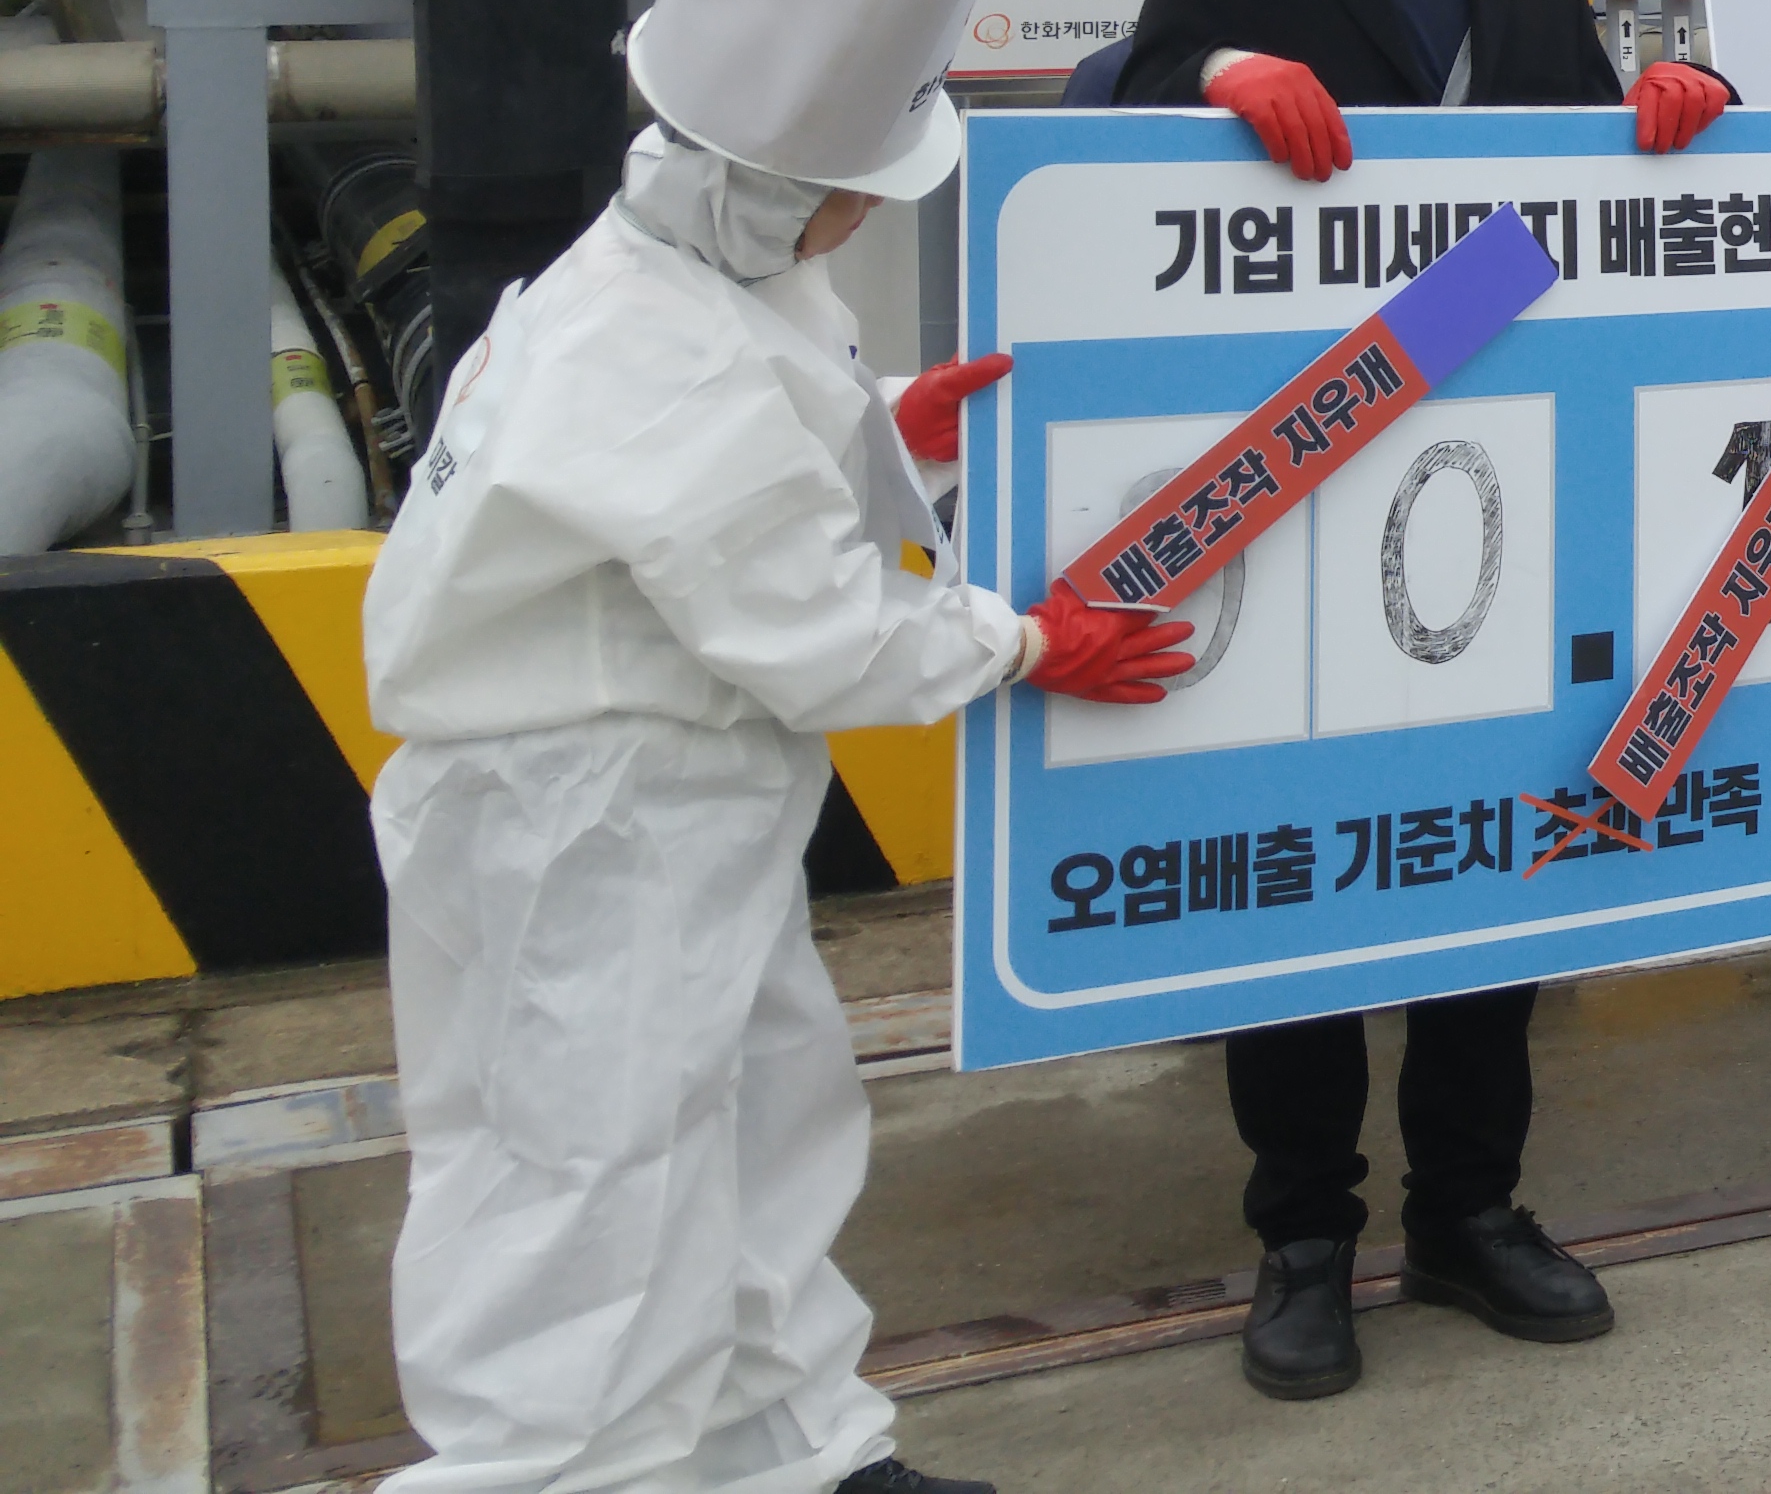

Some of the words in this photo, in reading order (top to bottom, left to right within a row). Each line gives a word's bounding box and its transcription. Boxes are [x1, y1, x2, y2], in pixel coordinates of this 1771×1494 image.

[1154, 207, 1293, 294] 기업
[1101, 448, 1280, 606] 배출조작
[1271, 340, 1405, 468] 지우개
[1616, 613, 1739, 787] 배출조작
[1047, 823, 1317, 933] 오염배출
[1335, 797, 1513, 892] 기준치
